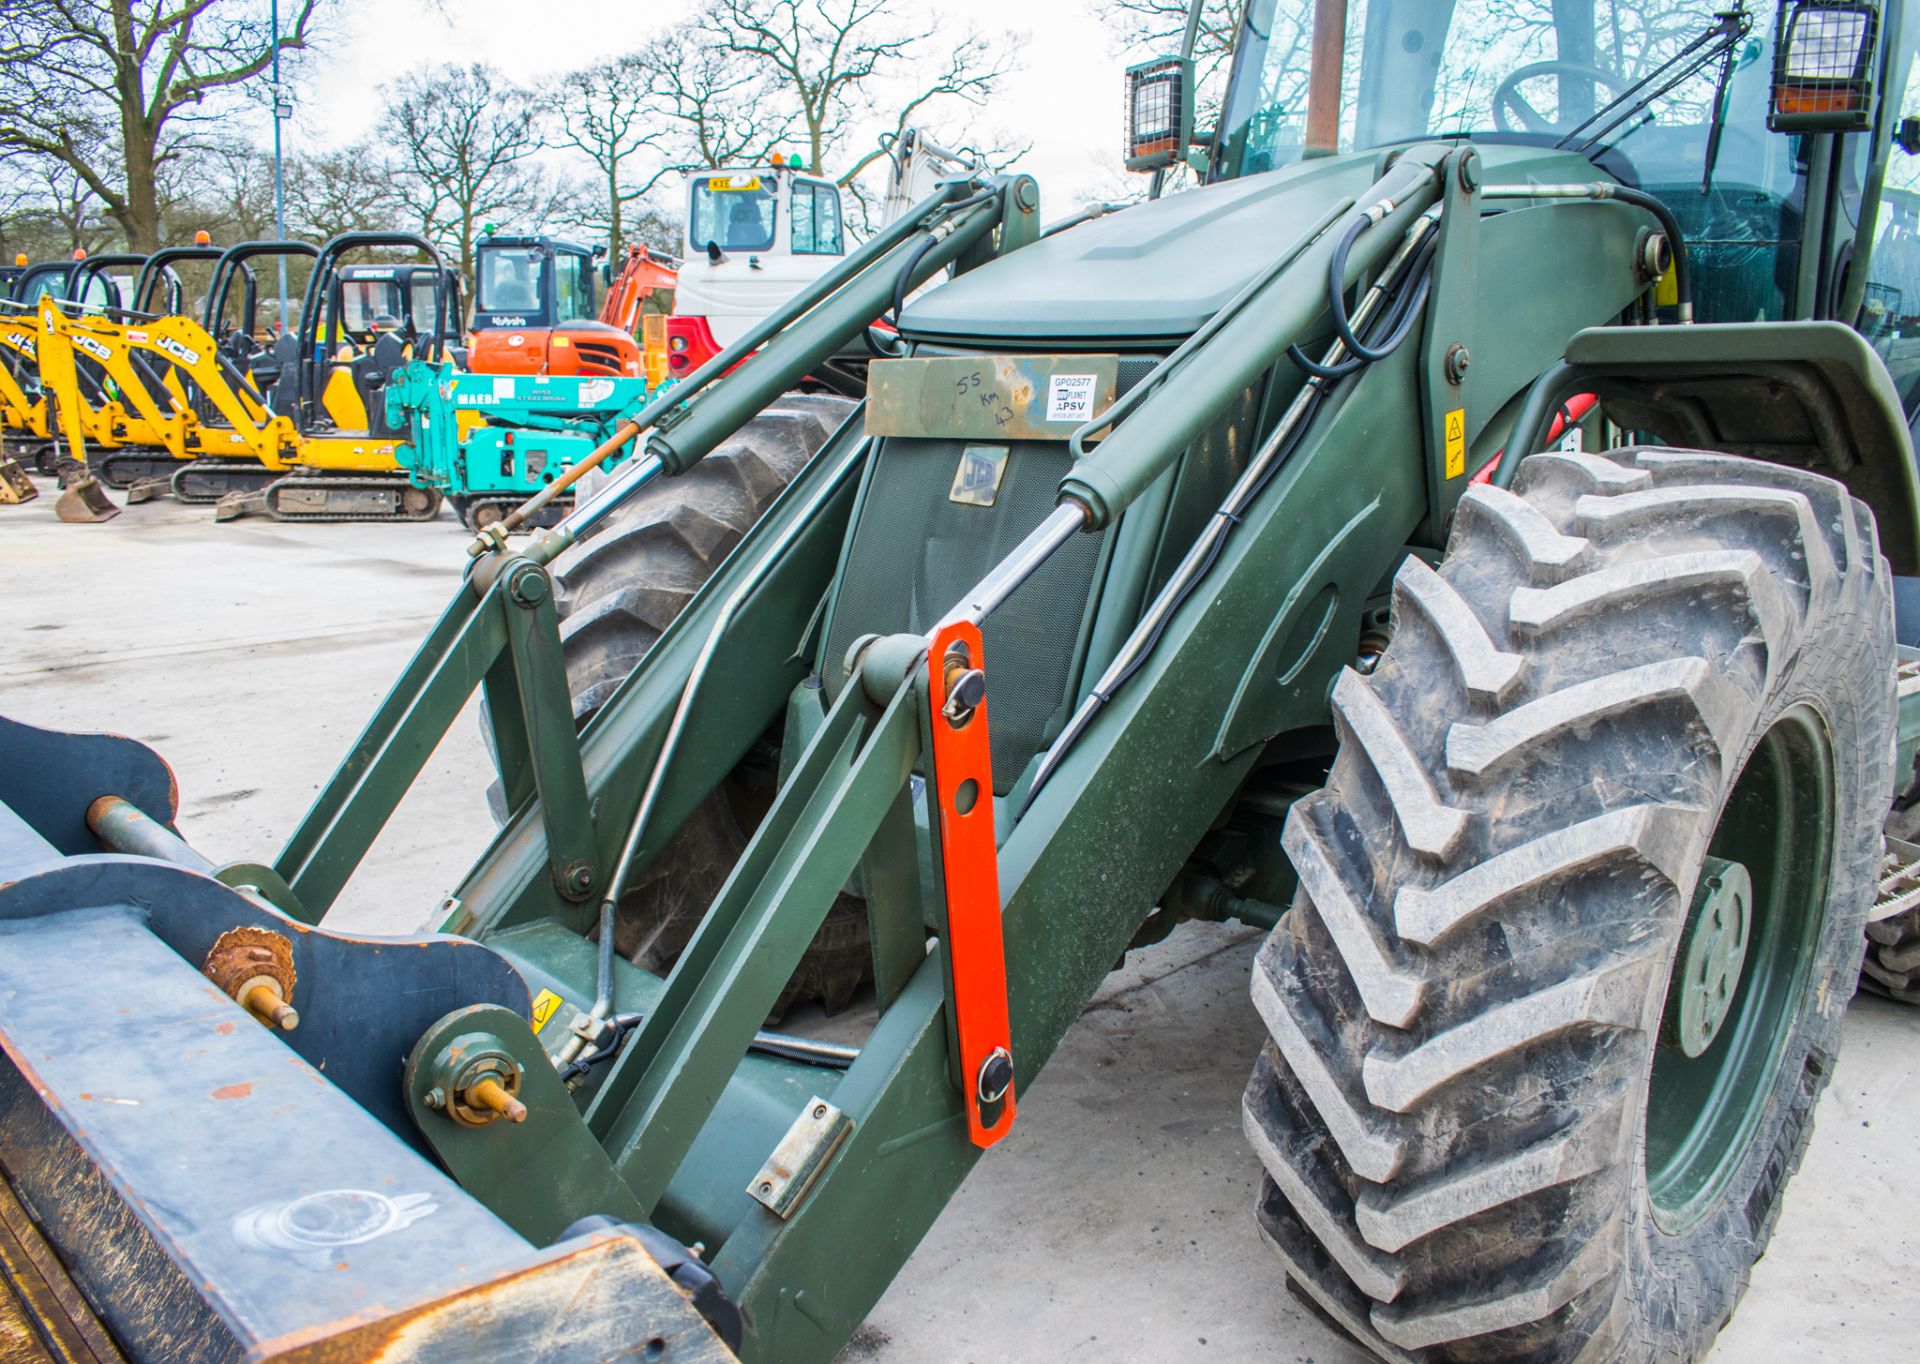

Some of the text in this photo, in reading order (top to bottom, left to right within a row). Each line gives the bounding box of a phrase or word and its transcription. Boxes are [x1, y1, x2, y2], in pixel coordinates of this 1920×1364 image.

[492, 316, 526, 326] Kubota
[70, 335, 112, 361] JCB
[155, 336, 201, 367] JCB
[956, 371, 981, 396] 55
[965, 456, 995, 488] JCB
